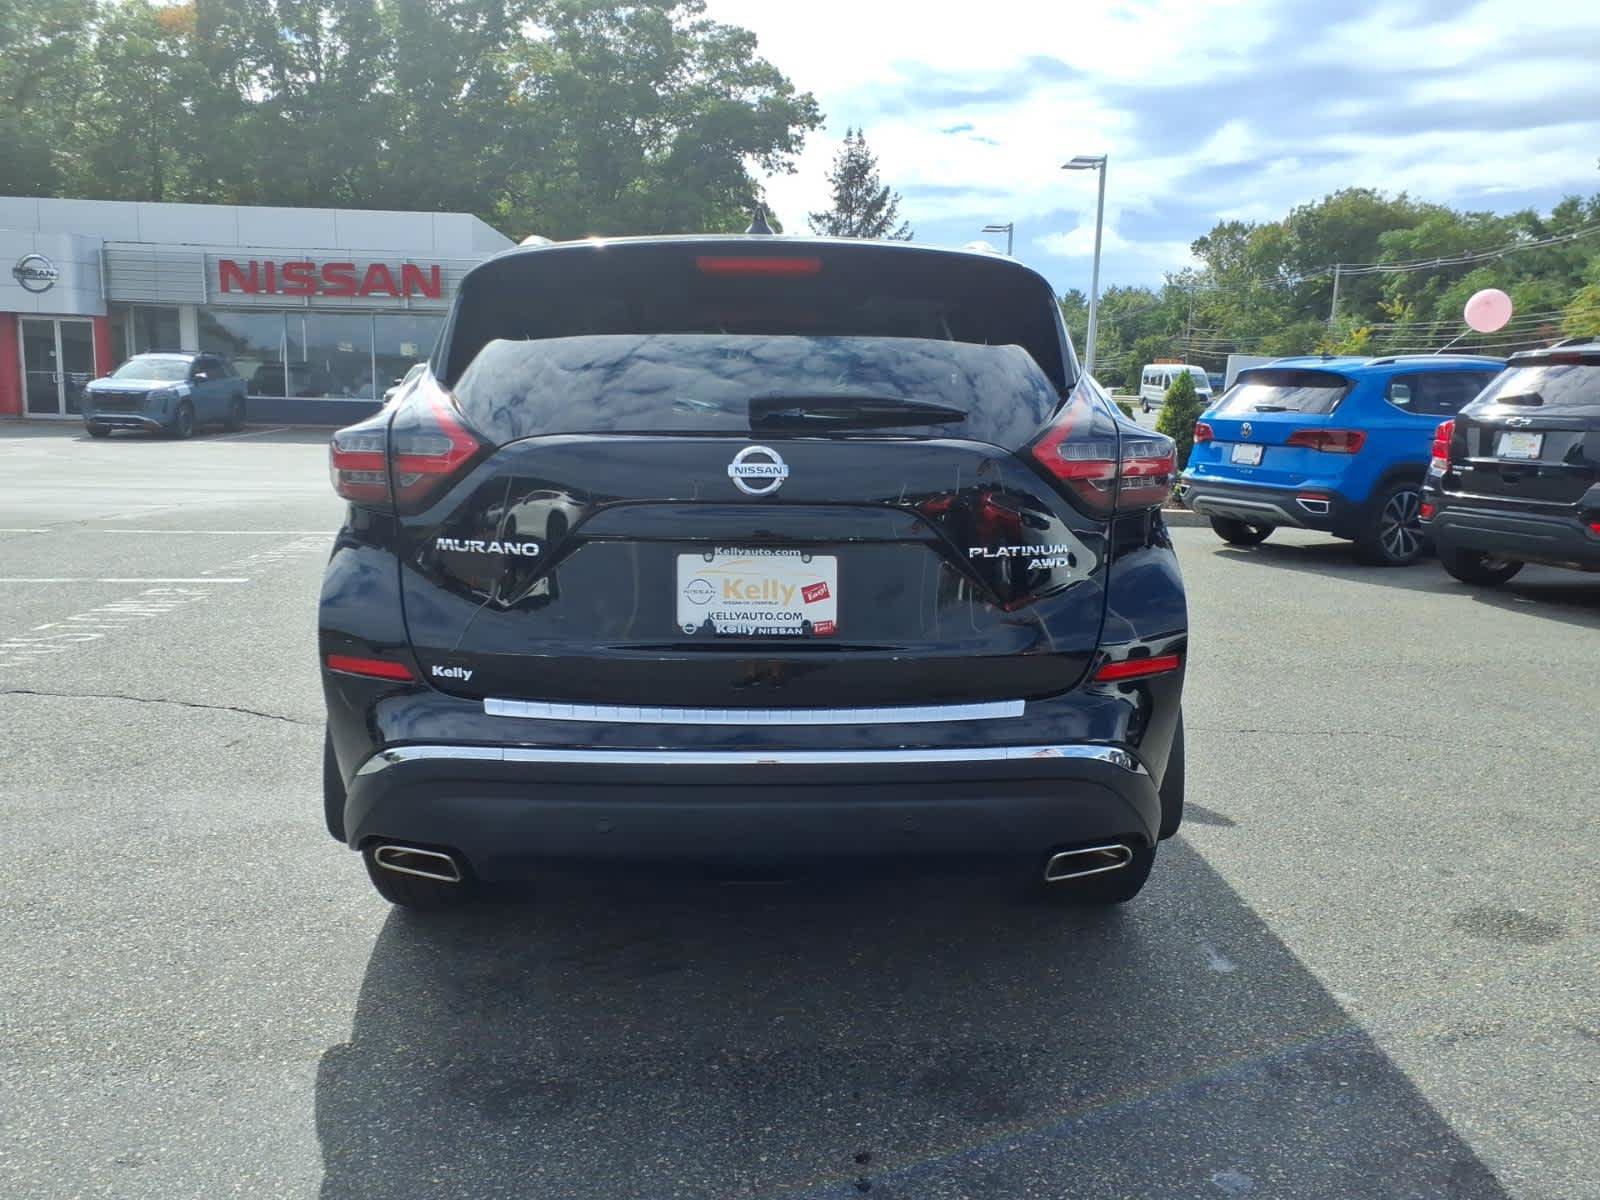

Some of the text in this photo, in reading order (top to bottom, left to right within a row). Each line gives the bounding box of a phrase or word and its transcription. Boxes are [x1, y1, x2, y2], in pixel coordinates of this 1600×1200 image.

[218, 259, 441, 298] NISSAN
[734, 465, 783, 475] NISSAN
[435, 537, 540, 557] MURANO
[713, 546, 801, 557] Kellyauto.com
[968, 543, 1069, 559] PLATINUM
[1027, 557, 1069, 570] AWD
[723, 578, 796, 607] Kelly
[707, 611, 803, 621] KELLYAUTO.COM
[715, 623, 803, 635] Kelly NISSAN
[431, 665, 473, 681] Kelly
